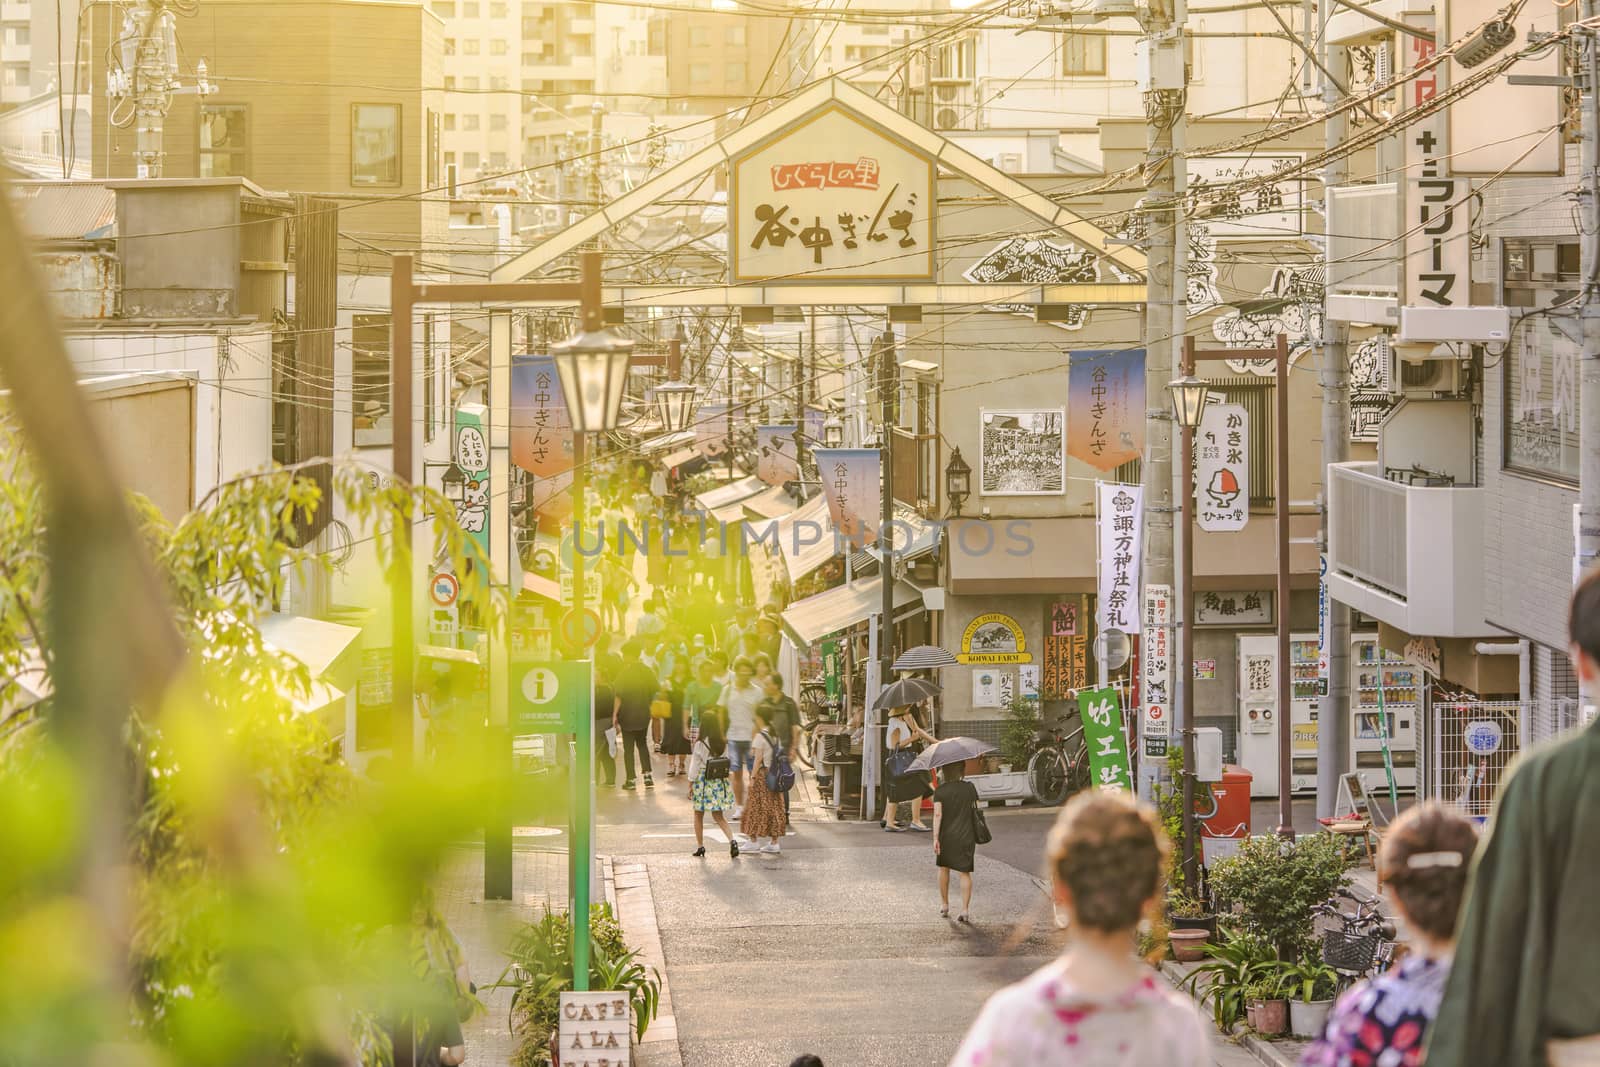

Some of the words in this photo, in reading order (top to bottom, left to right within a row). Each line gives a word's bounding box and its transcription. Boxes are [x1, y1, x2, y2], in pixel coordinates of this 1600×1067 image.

[774, 158, 880, 190] ひぐらしの里
[750, 183, 918, 264] 谷中ぎんざ
[533, 372, 551, 463] 谷中ぎんざ
[1090, 366, 1107, 456] 谷中ぎんざ
[462, 434, 472, 465] ぐるい
[471, 432, 483, 466] しにもの
[1226, 413, 1242, 464] かき氷
[1202, 508, 1243, 521] ひみつ堂
[1107, 515, 1134, 627] 諏方神社祭礼
[1053, 607, 1075, 633] 飴
[564, 1000, 625, 1021] CAFE
